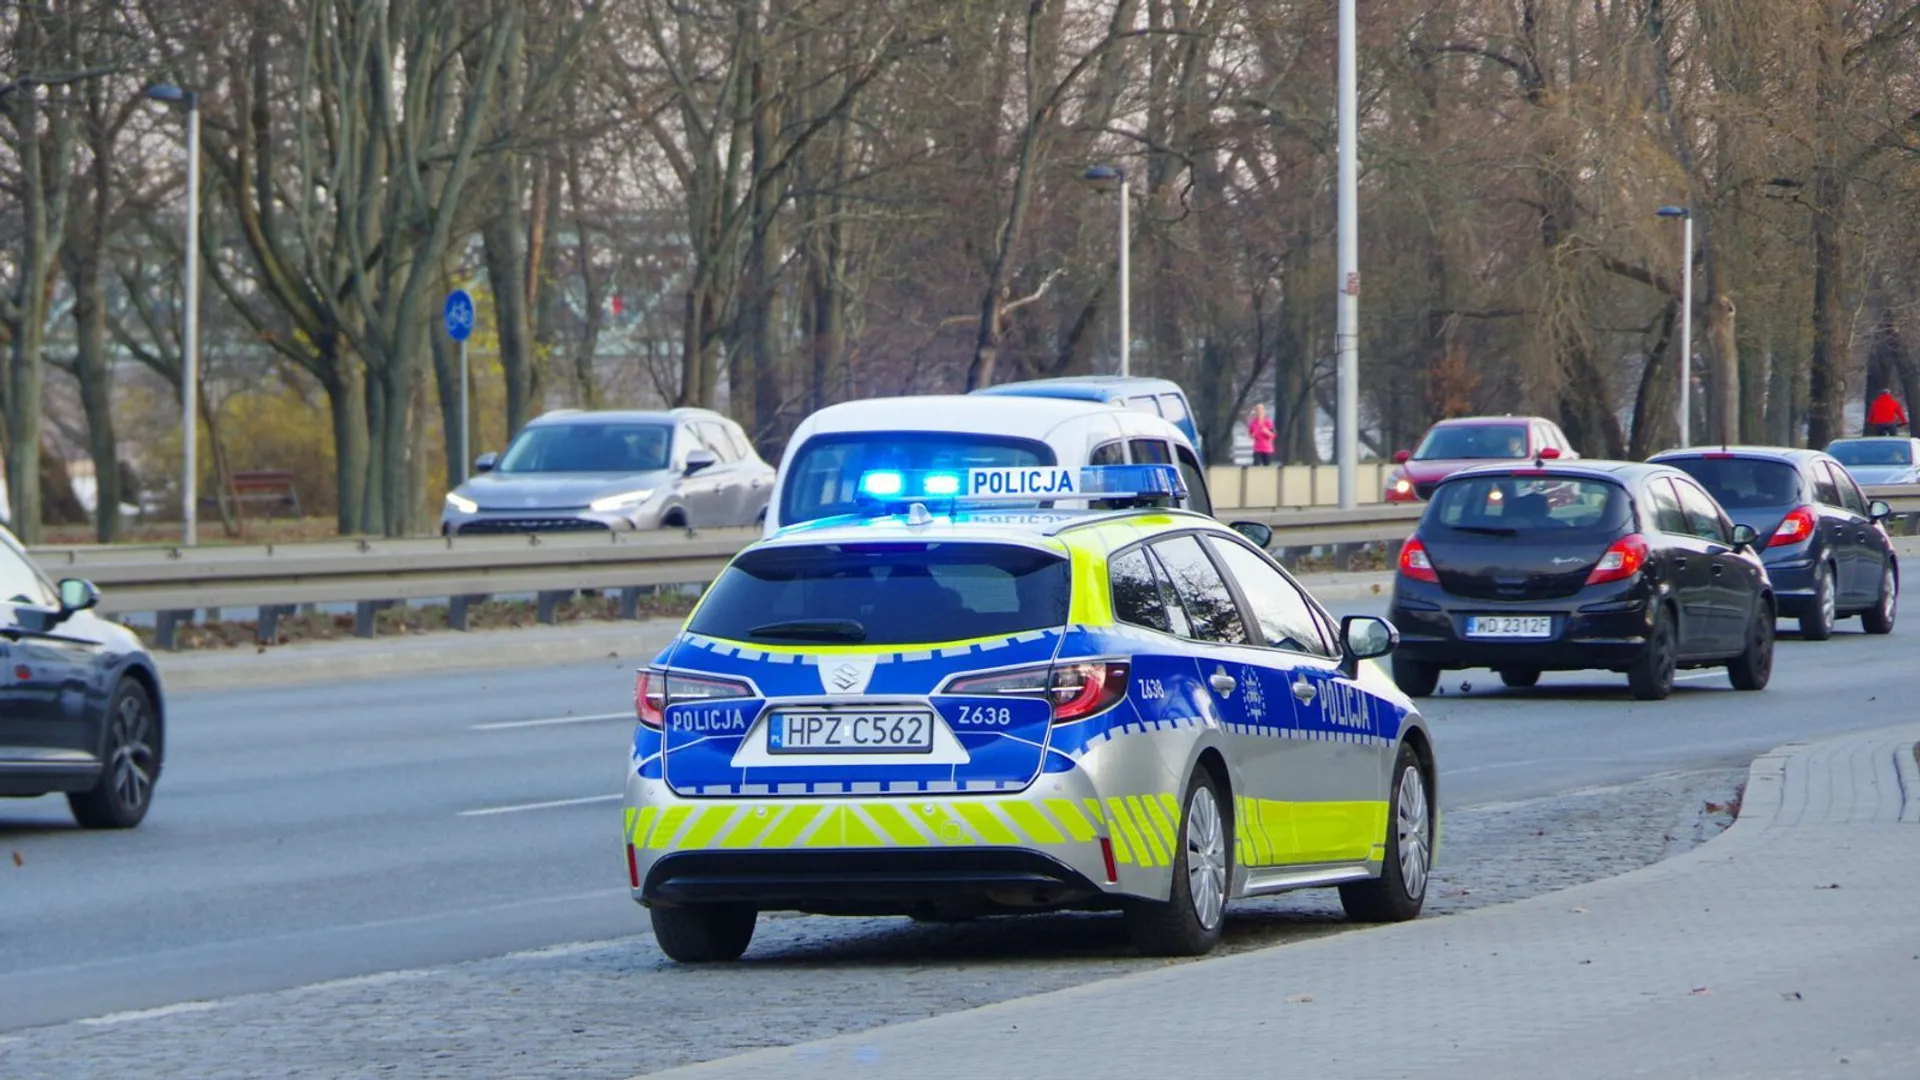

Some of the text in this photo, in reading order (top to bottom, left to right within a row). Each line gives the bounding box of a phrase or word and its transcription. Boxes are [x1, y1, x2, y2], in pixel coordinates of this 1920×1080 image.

[974, 471, 1074, 493] POLICJA
[1478, 618, 1497, 633] WD
[1503, 618, 1548, 633] 2312F
[1137, 679, 1165, 699] Z638
[1316, 678, 1371, 730] POLICJA
[672, 708, 745, 732] POLICJA
[958, 706, 1010, 725] Z638
[788, 717, 842, 745] HPZ
[853, 716, 923, 745] C562
